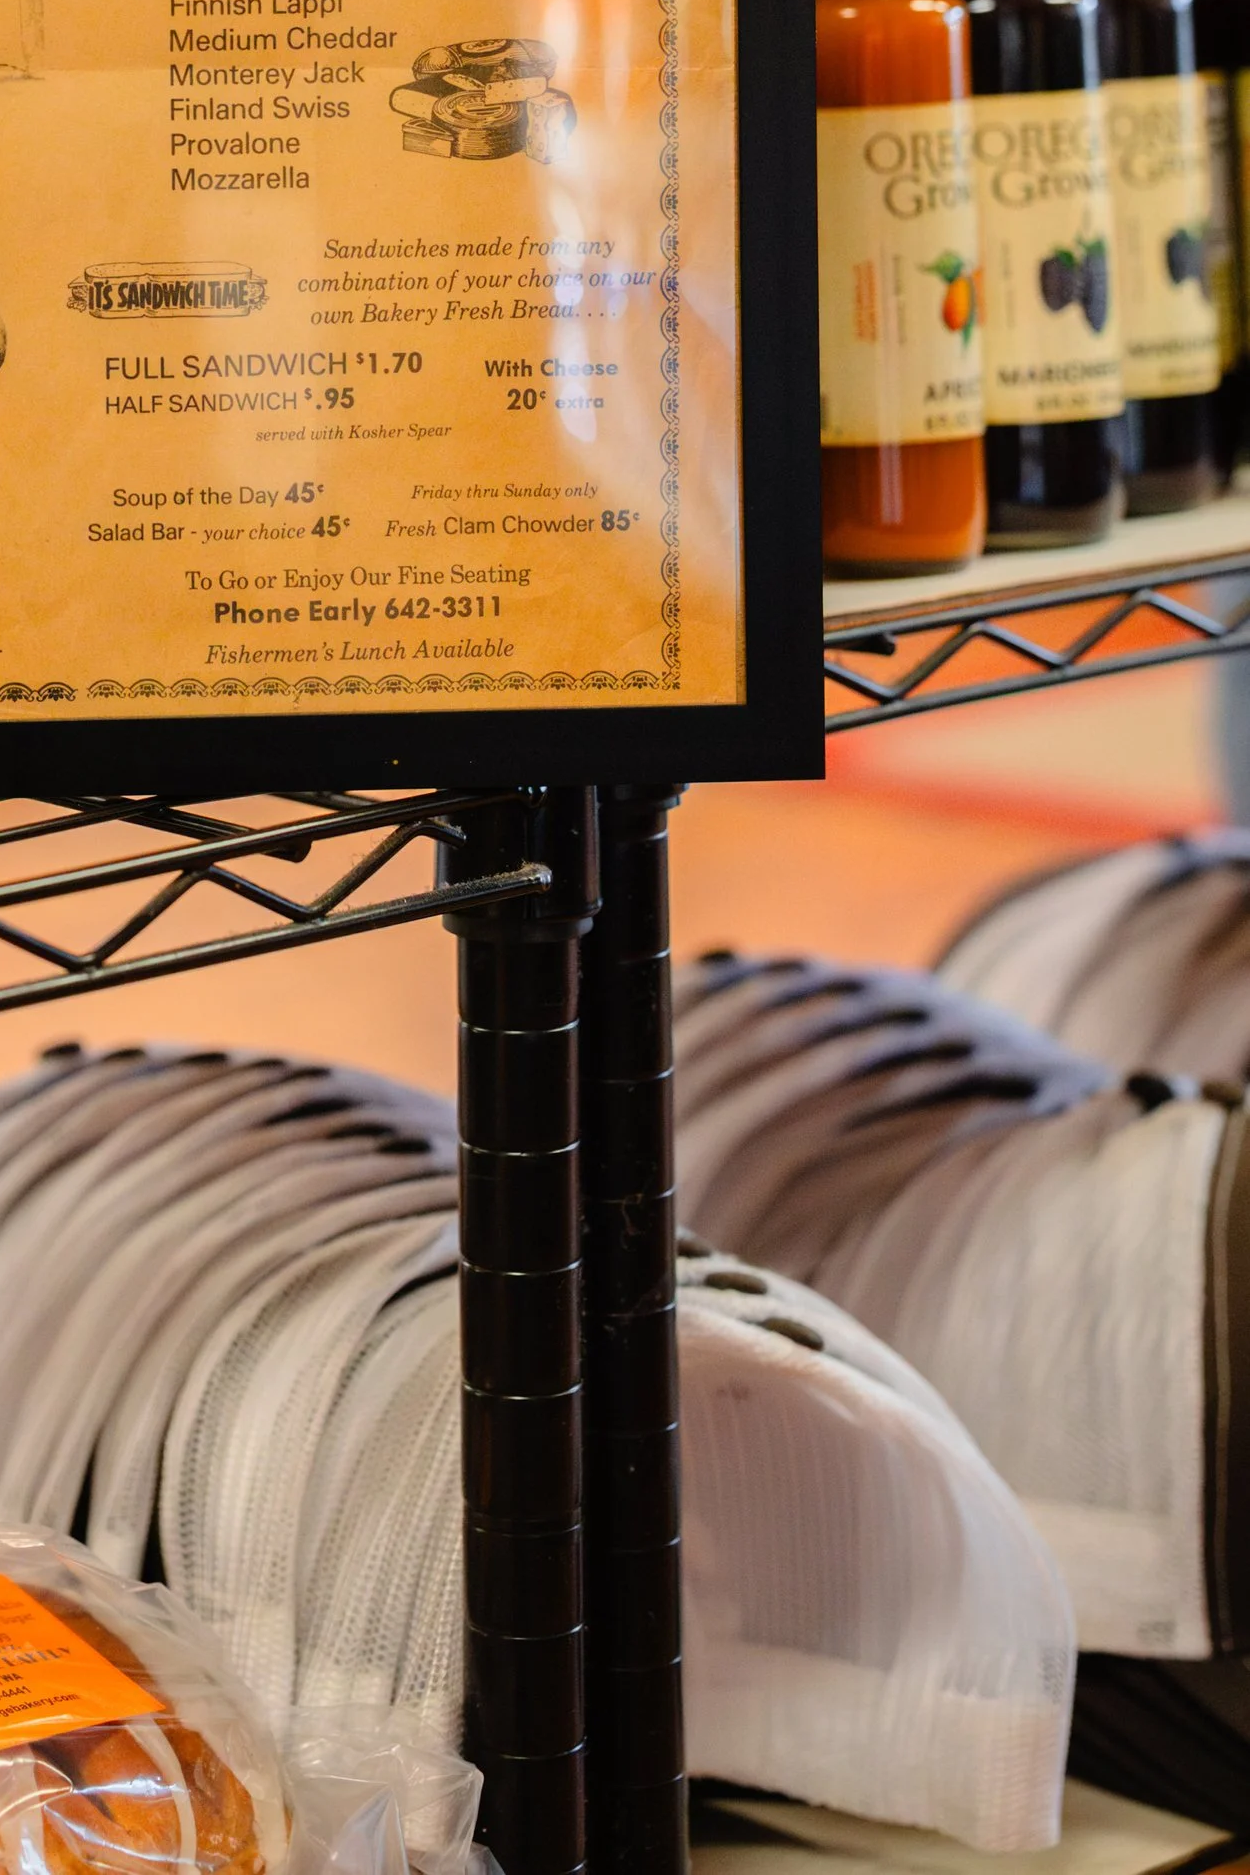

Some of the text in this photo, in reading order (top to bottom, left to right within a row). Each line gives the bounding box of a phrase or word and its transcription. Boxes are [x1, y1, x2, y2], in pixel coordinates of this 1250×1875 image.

[170, 26, 397, 52] Medium Cheddar
[170, 61, 364, 89] Monterey Jack
[171, 96, 350, 120] Finland Swiss
[171, 132, 300, 155] Provalone
[172, 166, 309, 190] Mozzarella
[324, 237, 616, 261] Sandwiches made from any
[298, 268, 657, 293] combination of your choice on our
[309, 300, 503, 326] own Bakery Fresh
[106, 352, 422, 379] FULL SANDWICH $1.70
[485, 359, 617, 377] With Cheese
[106, 396, 162, 414] HALF
[169, 393, 296, 413] SANDWICH
[507, 389, 604, 410] 20¢ extra
[256, 424, 452, 441] served with Kosher Spear
[114, 482, 323, 509] Soup of the Day 45¢
[411, 482, 597, 504] Friday thru Sunday only
[89, 515, 350, 544] Salad Bar your choice 45¢
[385, 510, 639, 536] Fresh Clam Chowder 85¢
[186, 564, 531, 592] To Go or Enjoy Our Fine Seating
[215, 596, 499, 626] Phone Early 642-3311
[340, 640, 405, 660] Lunch
[412, 638, 514, 658] Available
[0, 1672, 24, 1683] WA
